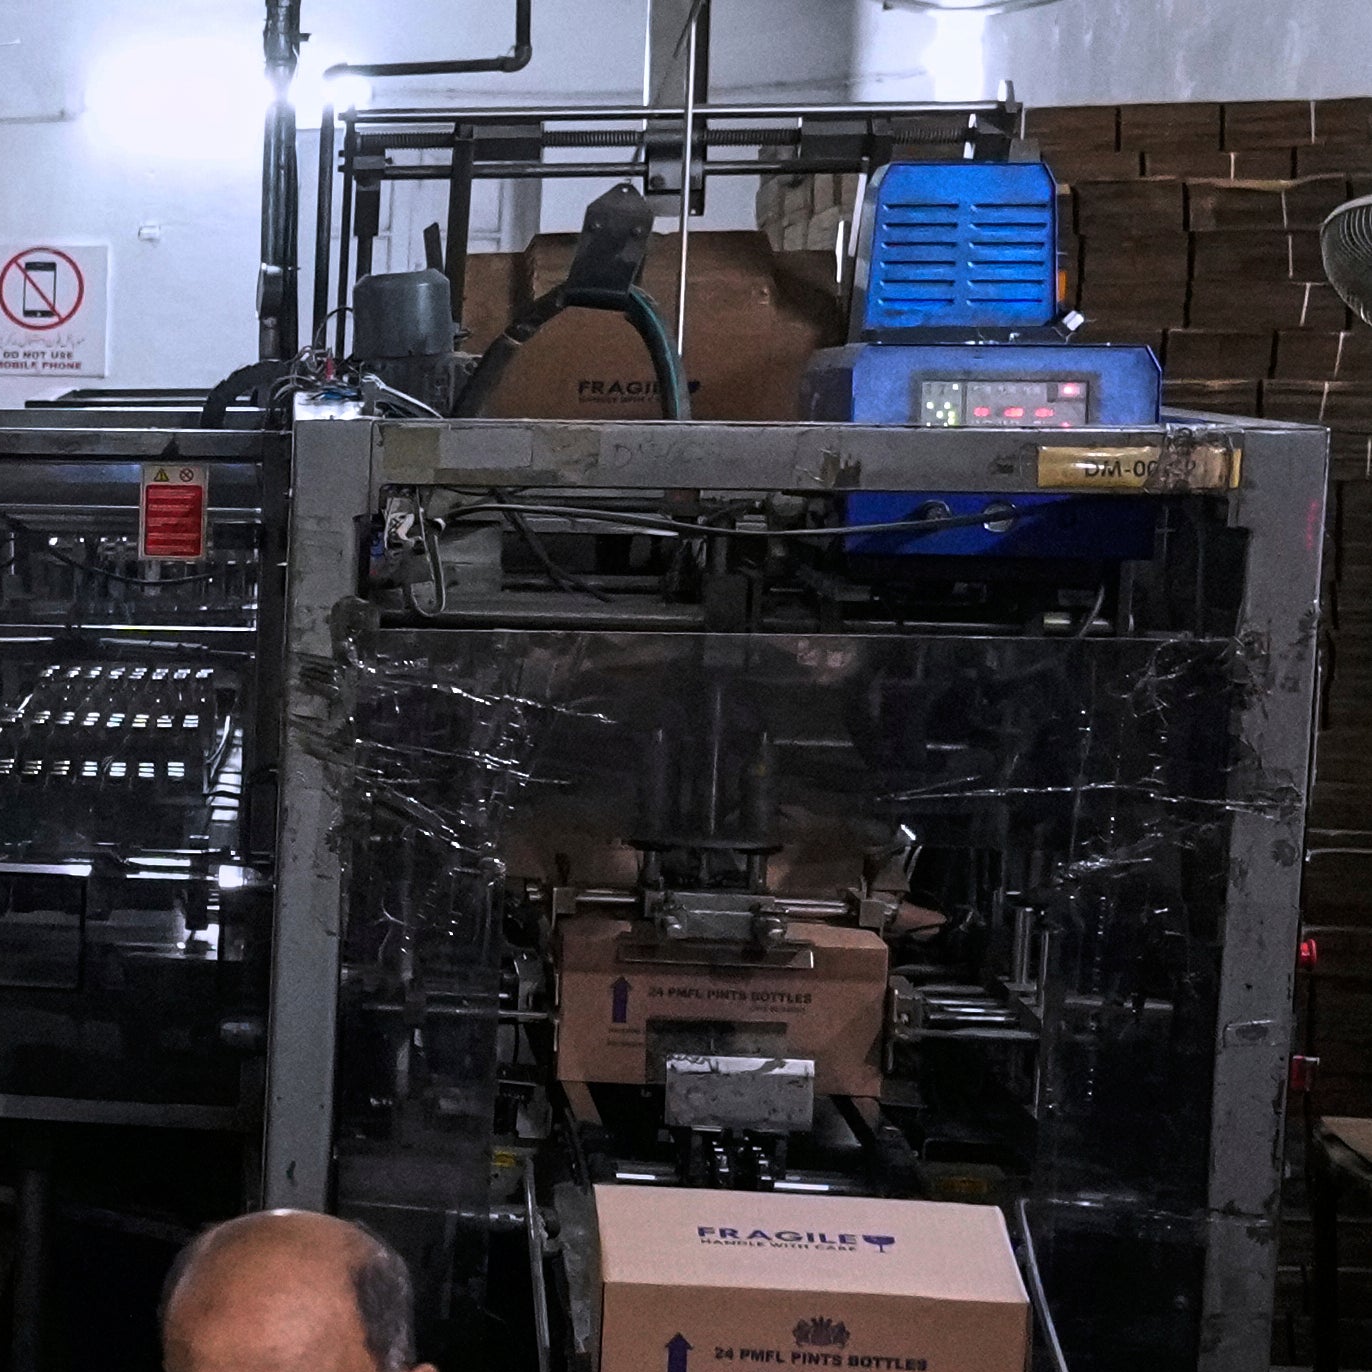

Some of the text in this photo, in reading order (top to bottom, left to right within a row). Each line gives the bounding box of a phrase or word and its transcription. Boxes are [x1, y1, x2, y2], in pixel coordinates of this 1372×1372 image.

[3, 351, 73, 359] DO NOT USE
[42, 361, 82, 369] PHONE
[649, 986, 813, 1005] 24 PMFL PINTS BOTTLES
[697, 1226, 856, 1245] FRAGILE
[700, 1239, 856, 1252] HANDLE WITH CARE
[714, 1346, 928, 1372] 24 PMFL PINTS BOTTLES
